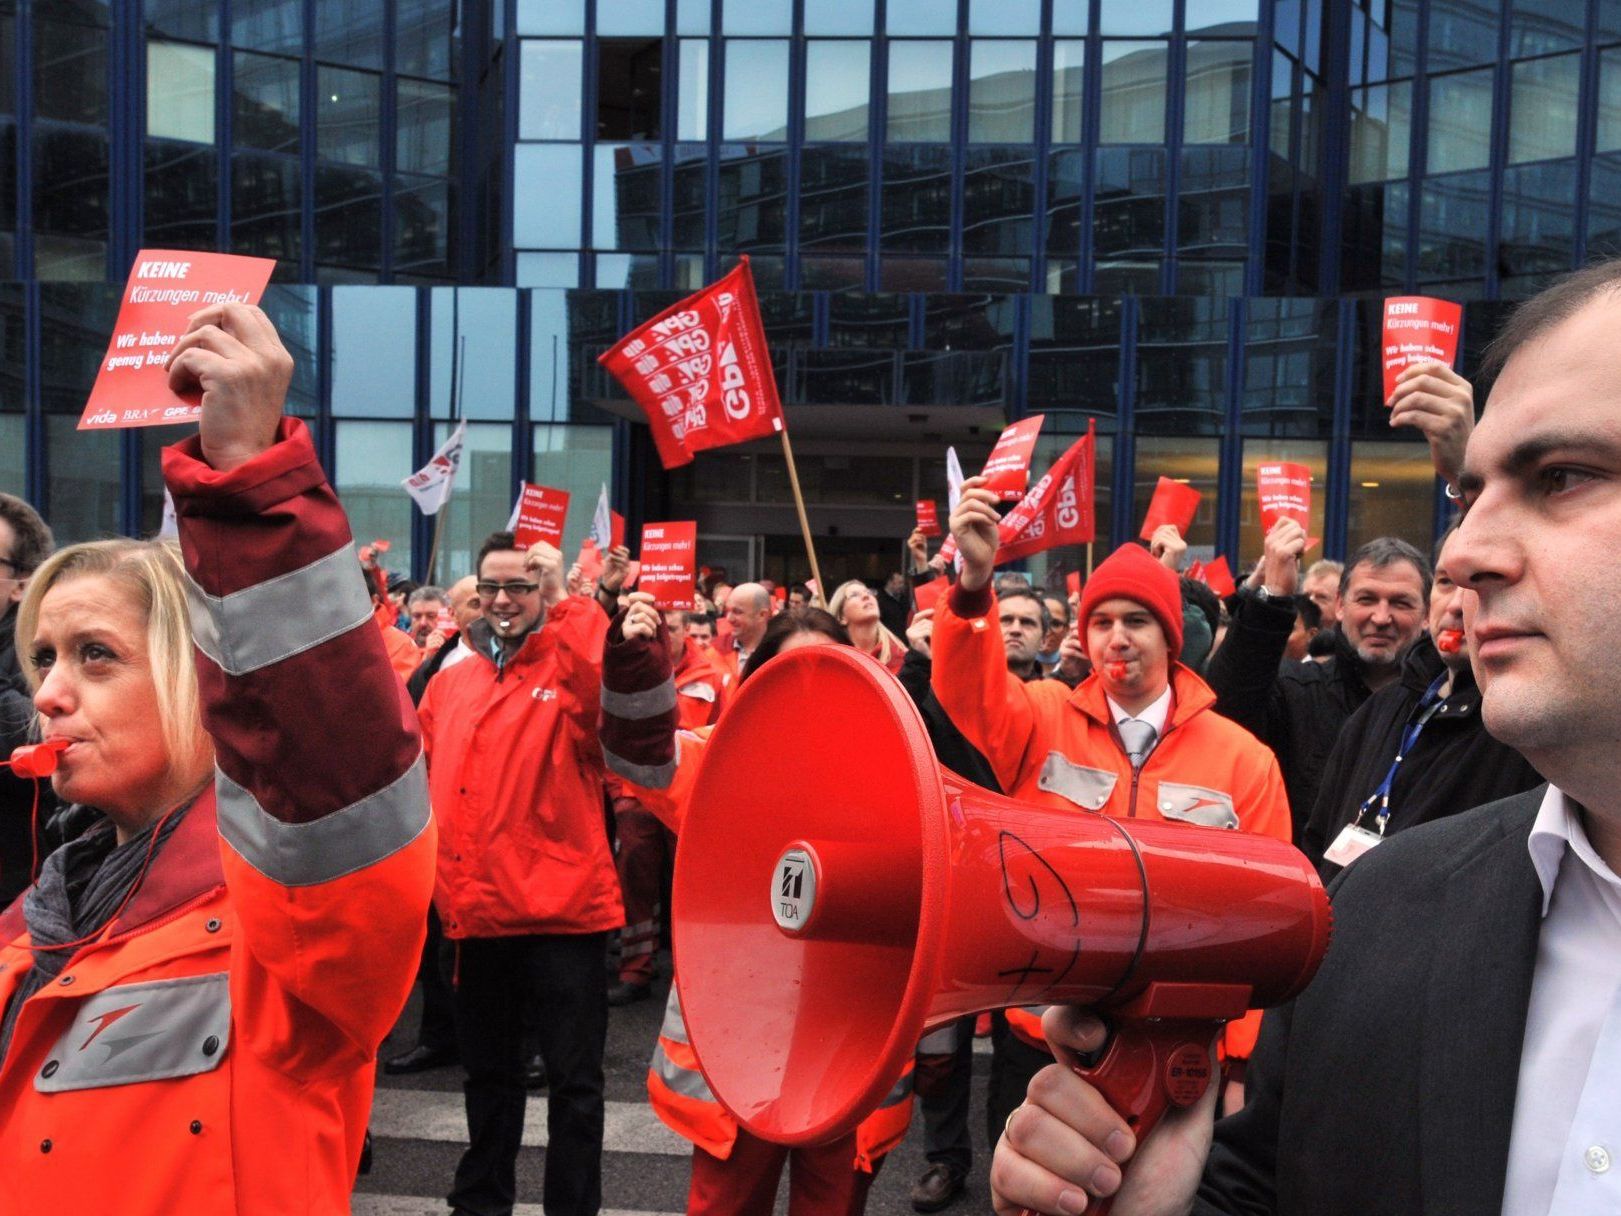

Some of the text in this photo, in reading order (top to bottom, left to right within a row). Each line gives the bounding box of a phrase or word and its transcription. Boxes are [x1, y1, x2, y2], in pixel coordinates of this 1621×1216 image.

[137, 261, 191, 279] KEINE
[129, 285, 199, 305] Kürzungen
[1388, 303, 1418, 315] KEINE
[1431, 320, 1454, 335] mehr!
[116, 333, 137, 349] Wir
[139, 331, 176, 347] haben
[107, 355, 142, 372] genug
[86, 408, 117, 425] vida
[780, 902, 799, 920] TOA
